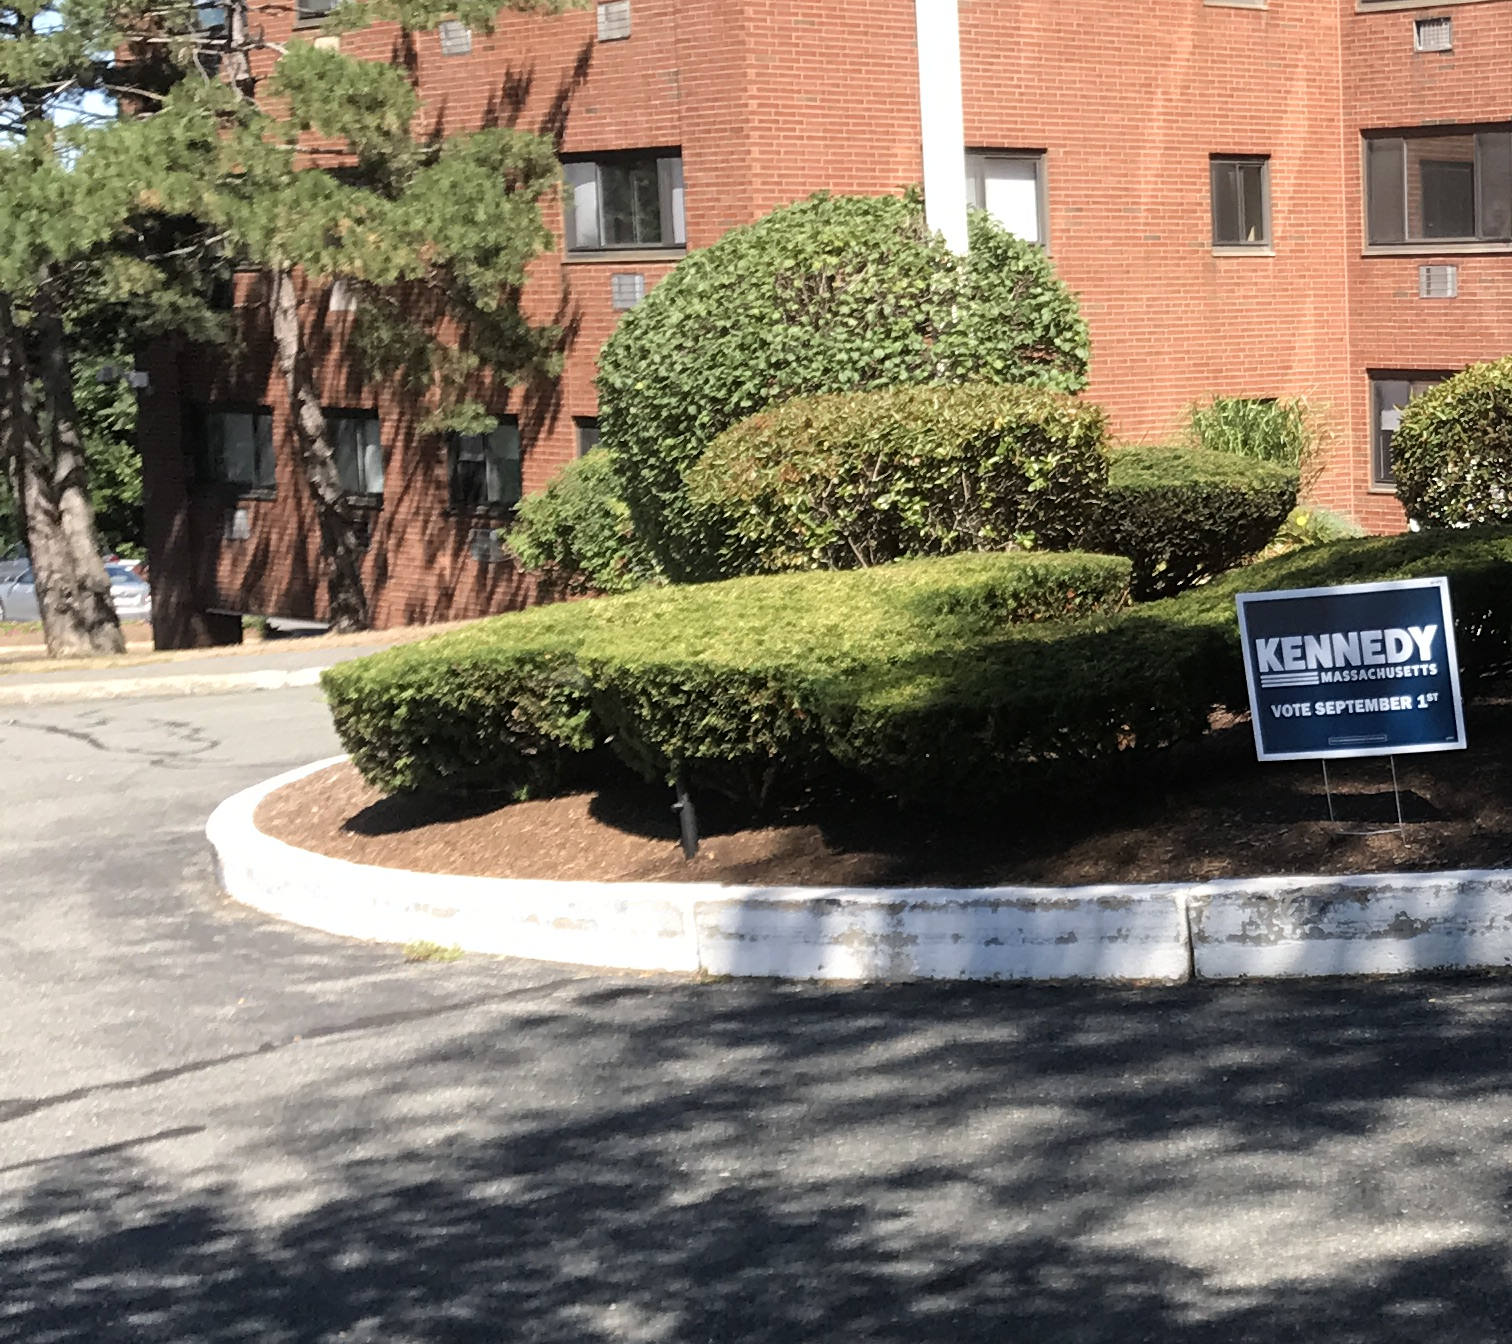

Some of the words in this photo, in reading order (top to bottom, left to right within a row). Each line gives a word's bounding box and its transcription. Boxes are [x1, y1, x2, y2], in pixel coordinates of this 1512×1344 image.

[1256, 625, 1438, 672] KENNEDY
[1320, 664, 1438, 683] MASSACHUSETTS
[1271, 703, 1312, 718] VOTE
[1314, 696, 1412, 716] SEPTEMBER
[1416, 692, 1439, 709] 1ST
